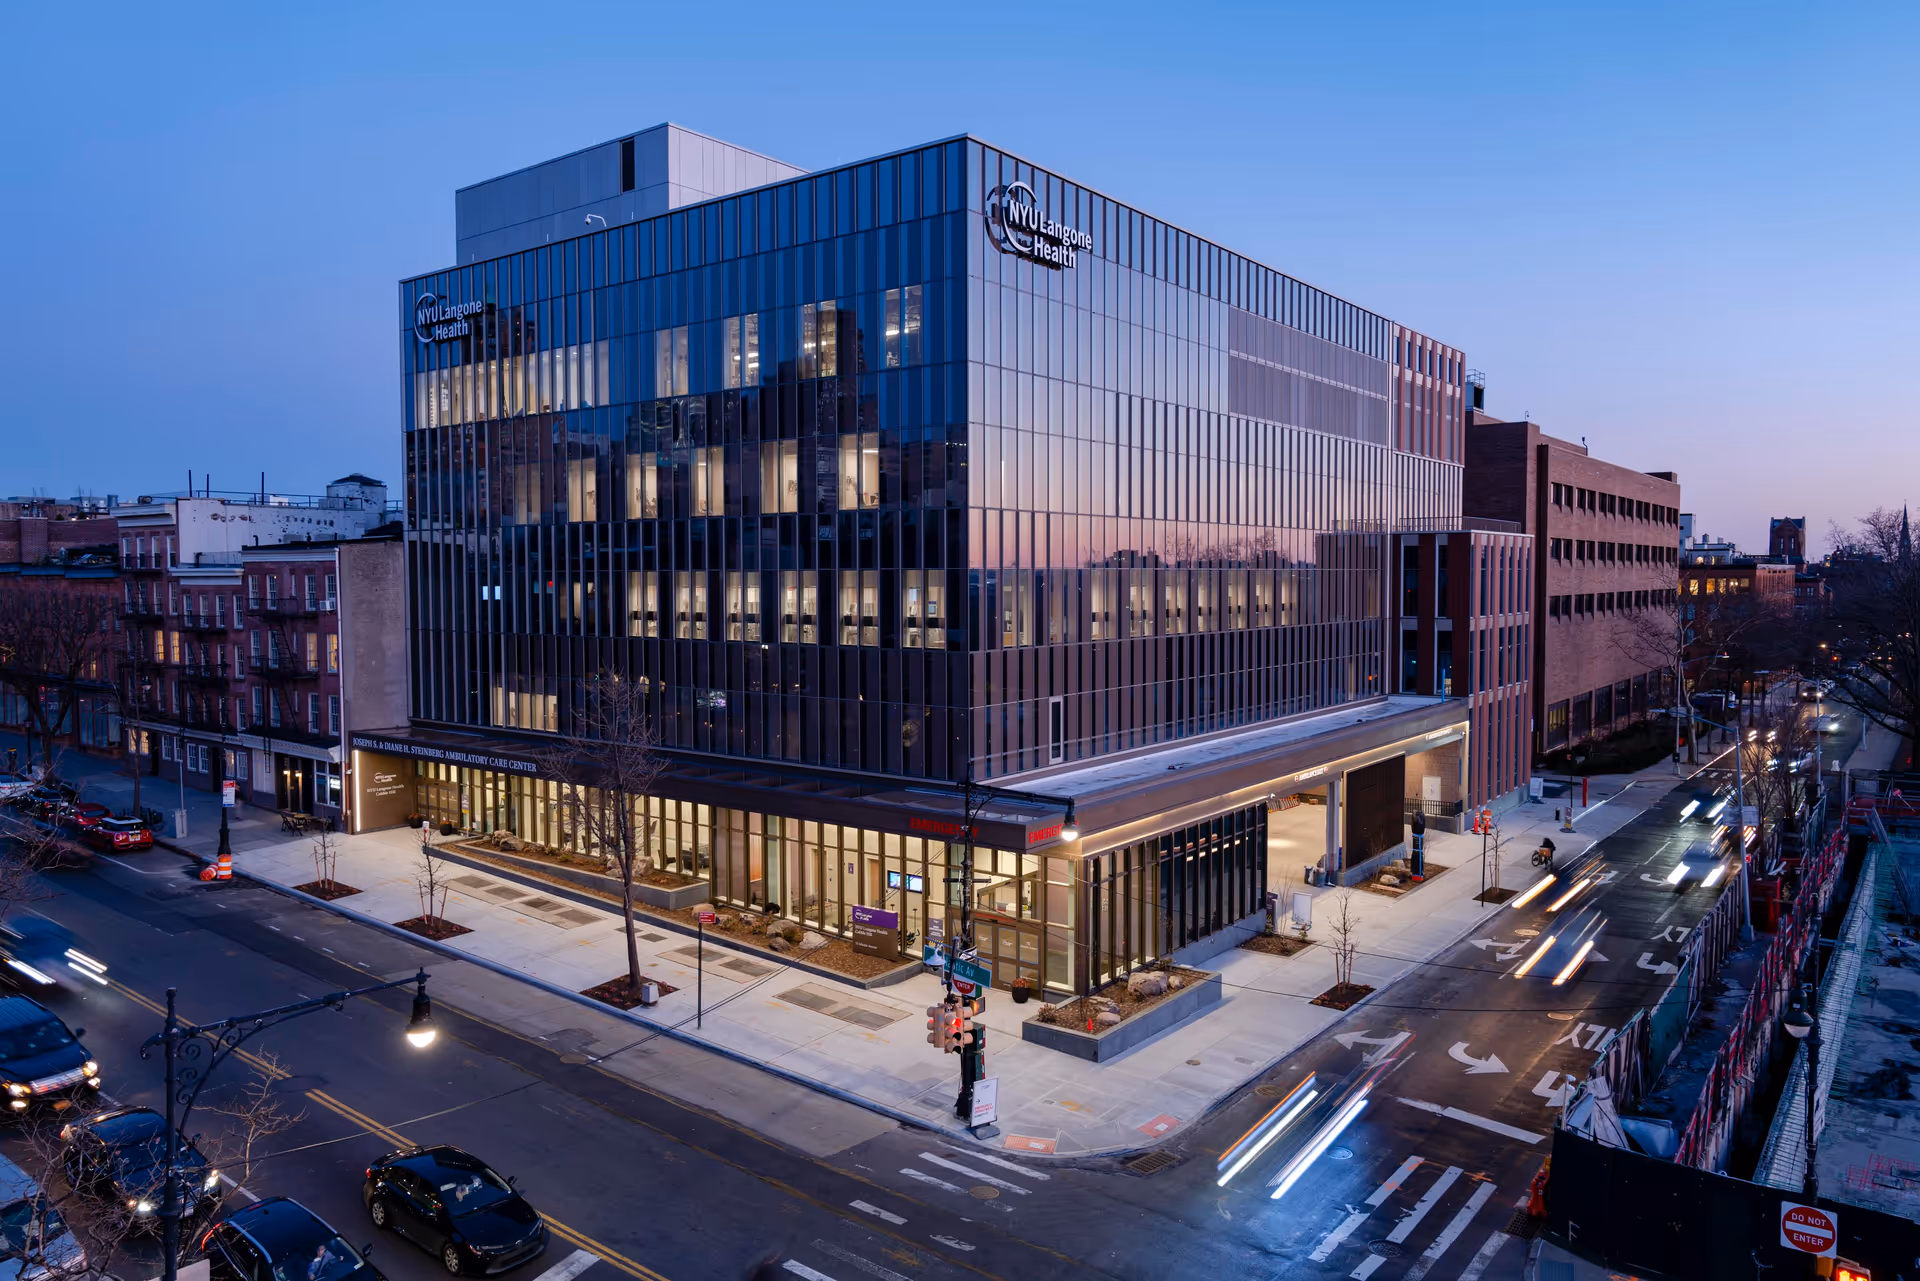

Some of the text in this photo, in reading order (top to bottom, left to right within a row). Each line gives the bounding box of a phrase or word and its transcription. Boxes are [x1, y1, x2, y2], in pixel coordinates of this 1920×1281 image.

[1010, 199, 1092, 250] NYU Langone
[1034, 235, 1076, 269] Health
[418, 300, 482, 326] NYU Langone
[435, 319, 468, 341] Health
[352, 737, 373, 748] JOSEPH
[379, 741, 384, 749] &
[384, 741, 403, 752] DIANE
[410, 745, 444, 759] STEINBERG
[445, 750, 488, 765] AMBULATORY
[489, 757, 508, 768] CARE
[508, 759, 537, 772] CENTER
[910, 817, 979, 838] EMERGENY
[1028, 819, 1079, 844] EMERGE
[957, 980, 971, 990] ENTER
[1791, 1213, 1827, 1227] DO NOT
[1793, 1232, 1824, 1247] ENTER
